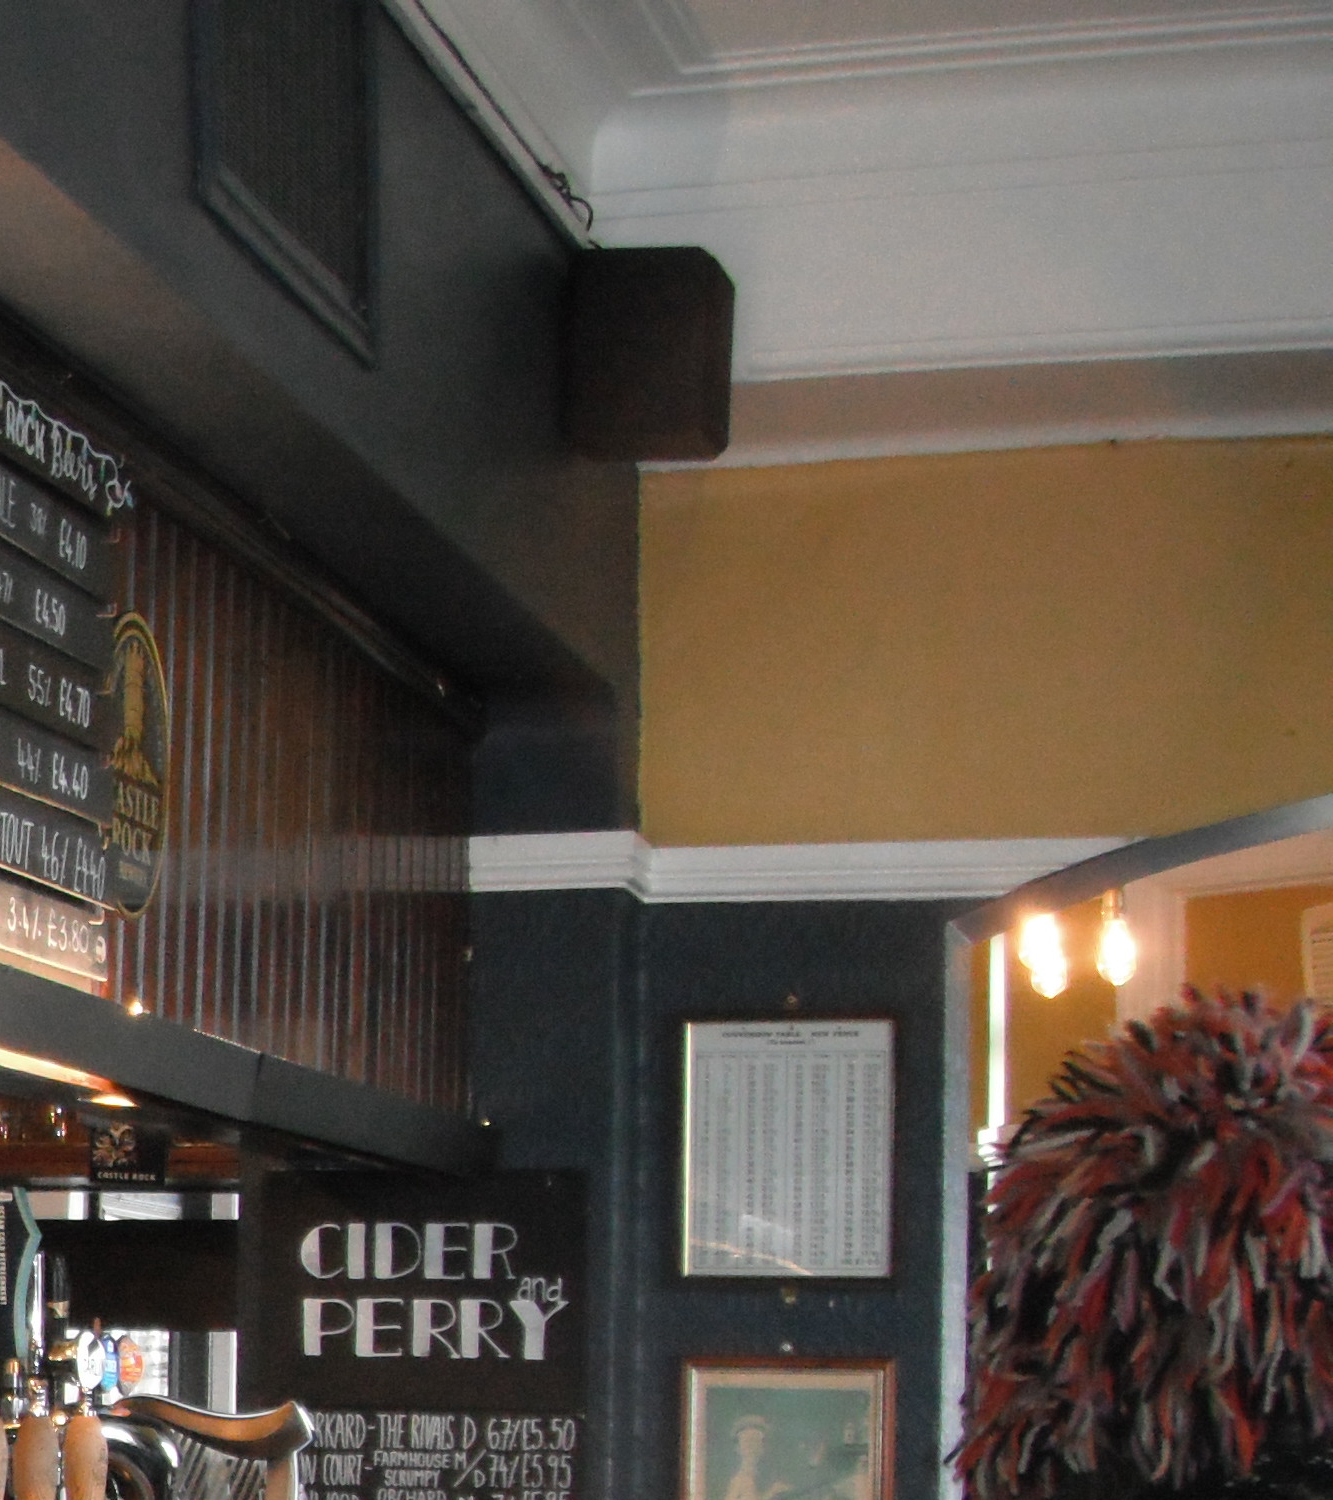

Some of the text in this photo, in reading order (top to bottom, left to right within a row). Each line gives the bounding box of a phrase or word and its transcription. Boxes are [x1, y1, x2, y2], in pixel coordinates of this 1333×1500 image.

[299, 1222, 518, 1280] CIDER
[515, 1276, 564, 1302] and
[303, 1297, 570, 1361] PERRY
[377, 1414, 477, 1450] THE D
[324, 1450, 453, 1486] COURT FARMHOUSE
[384, 1469, 441, 1488] SCRUMPY
